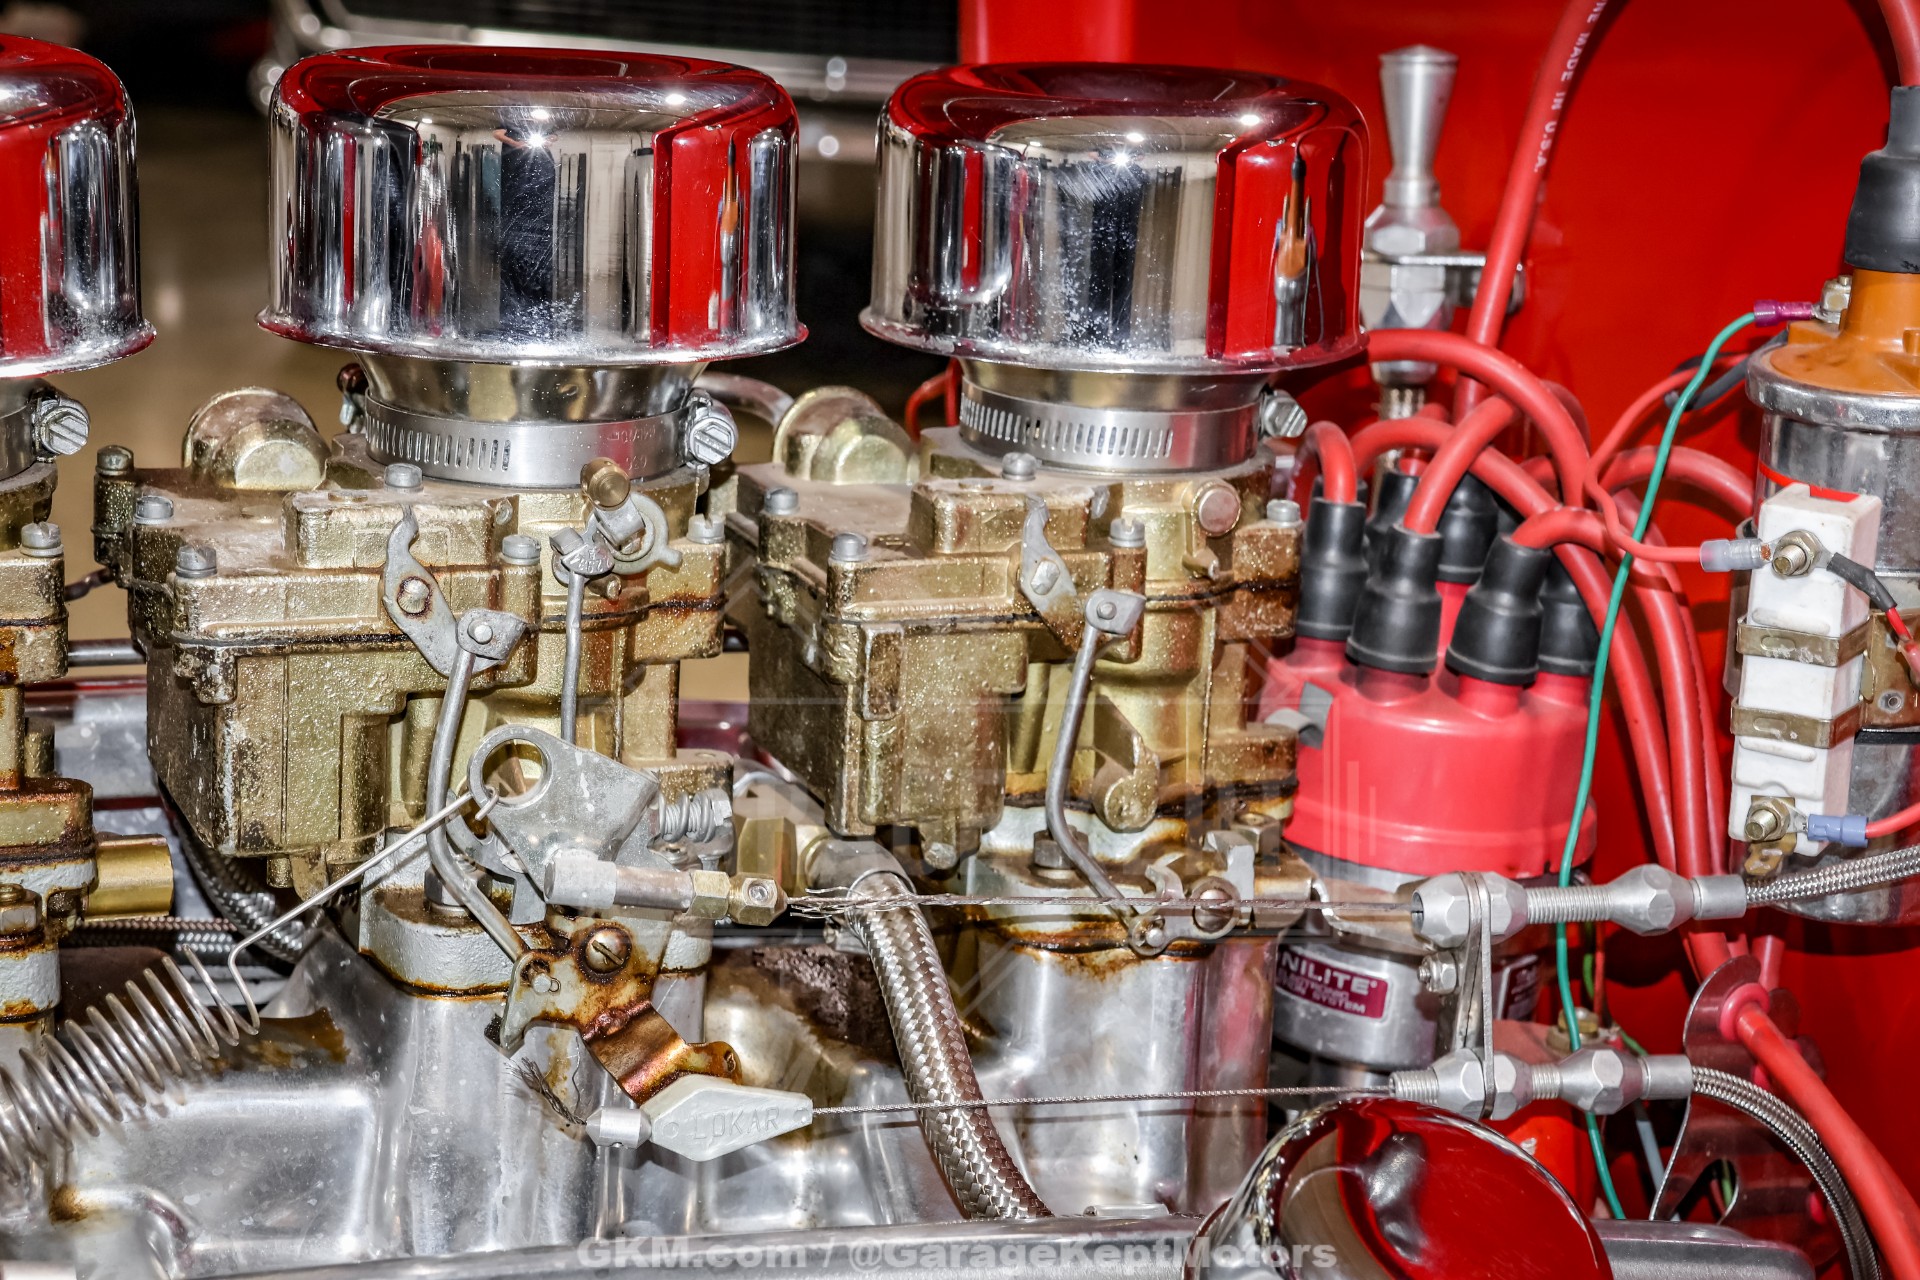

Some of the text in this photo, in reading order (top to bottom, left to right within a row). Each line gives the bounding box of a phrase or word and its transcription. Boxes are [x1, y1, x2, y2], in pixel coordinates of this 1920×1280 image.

[1561, 32, 1590, 81] MADE
[1551, 92, 1566, 110] IN
[1534, 121, 1557, 172] U.S.A.
[1278, 951, 1372, 995] NILITE
[692, 1106, 780, 1140] LOKAR
